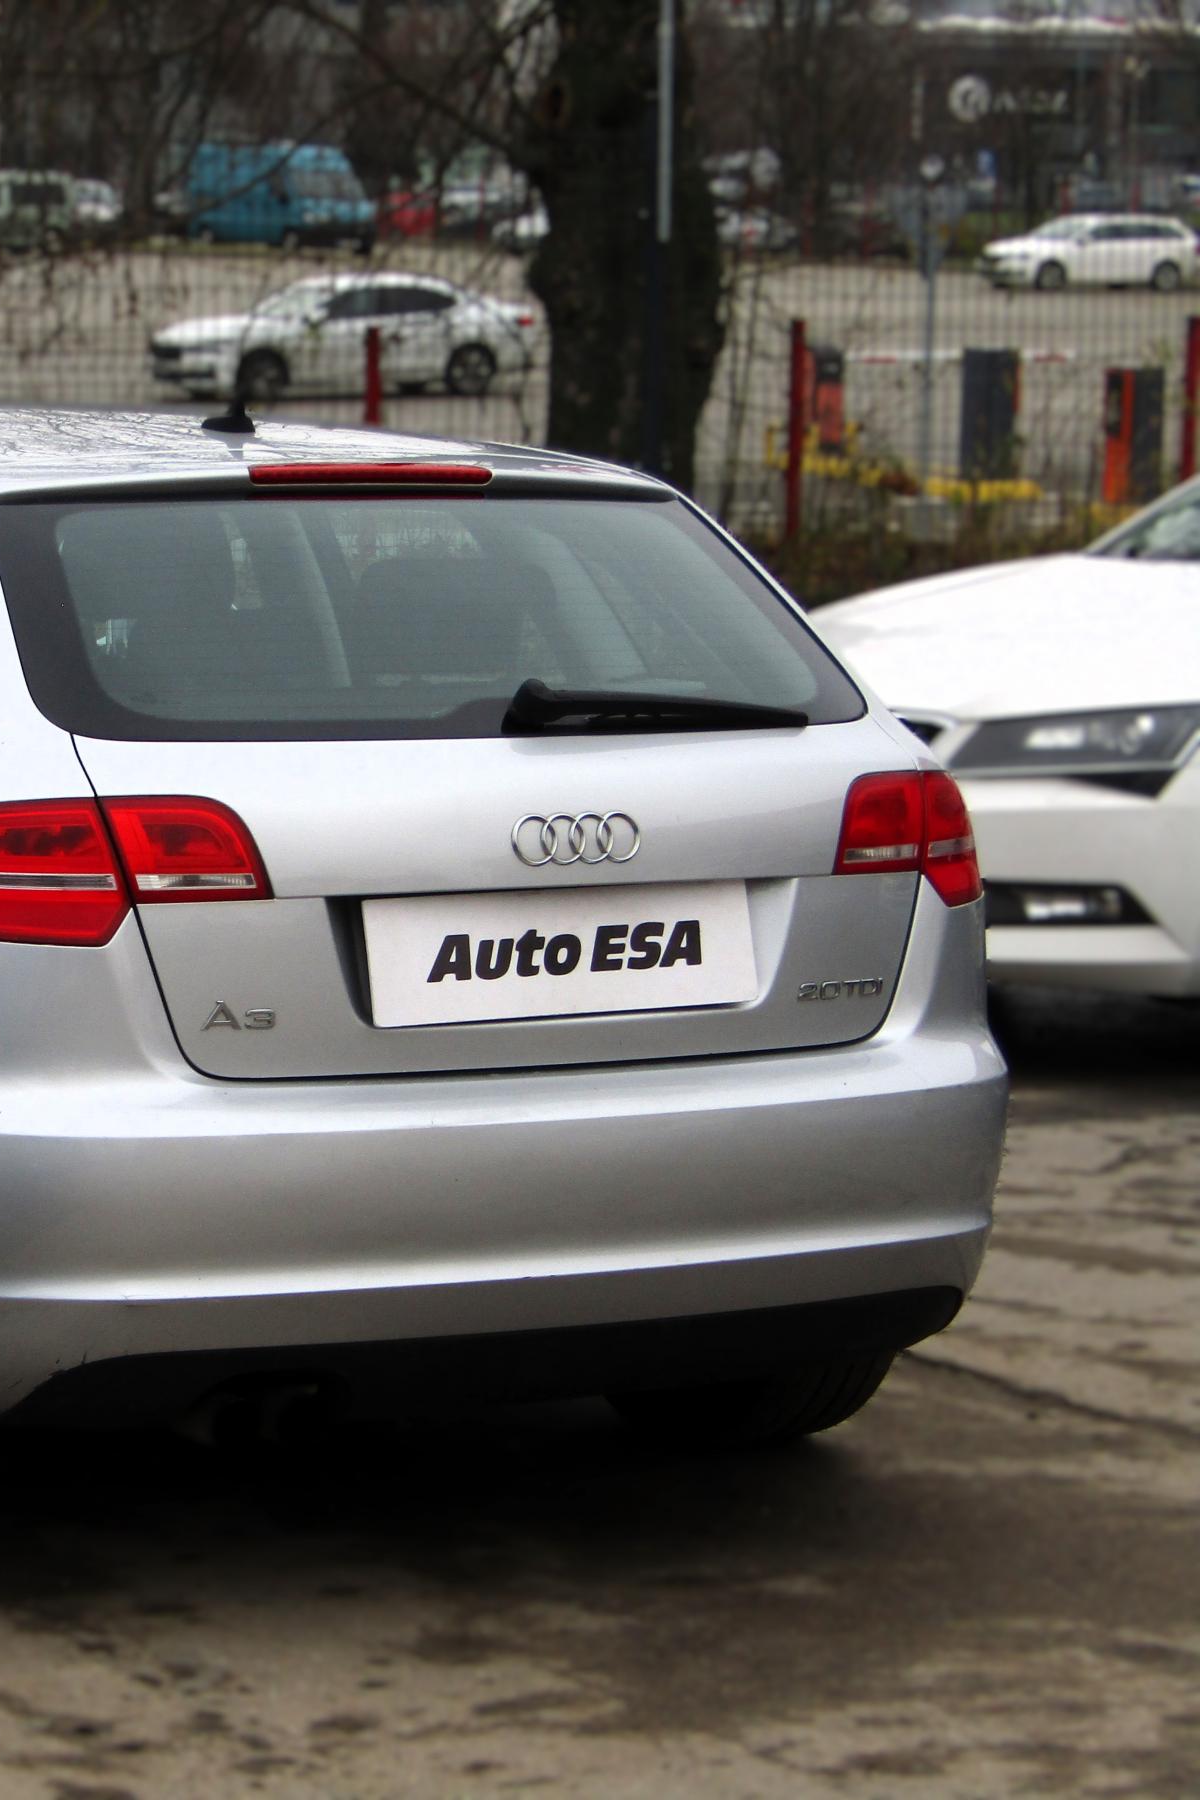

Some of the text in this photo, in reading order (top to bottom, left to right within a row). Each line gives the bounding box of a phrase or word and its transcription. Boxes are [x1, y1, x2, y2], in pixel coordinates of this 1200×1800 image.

[427, 919, 703, 983] Auto ESA
[200, 999, 275, 1031] A3
